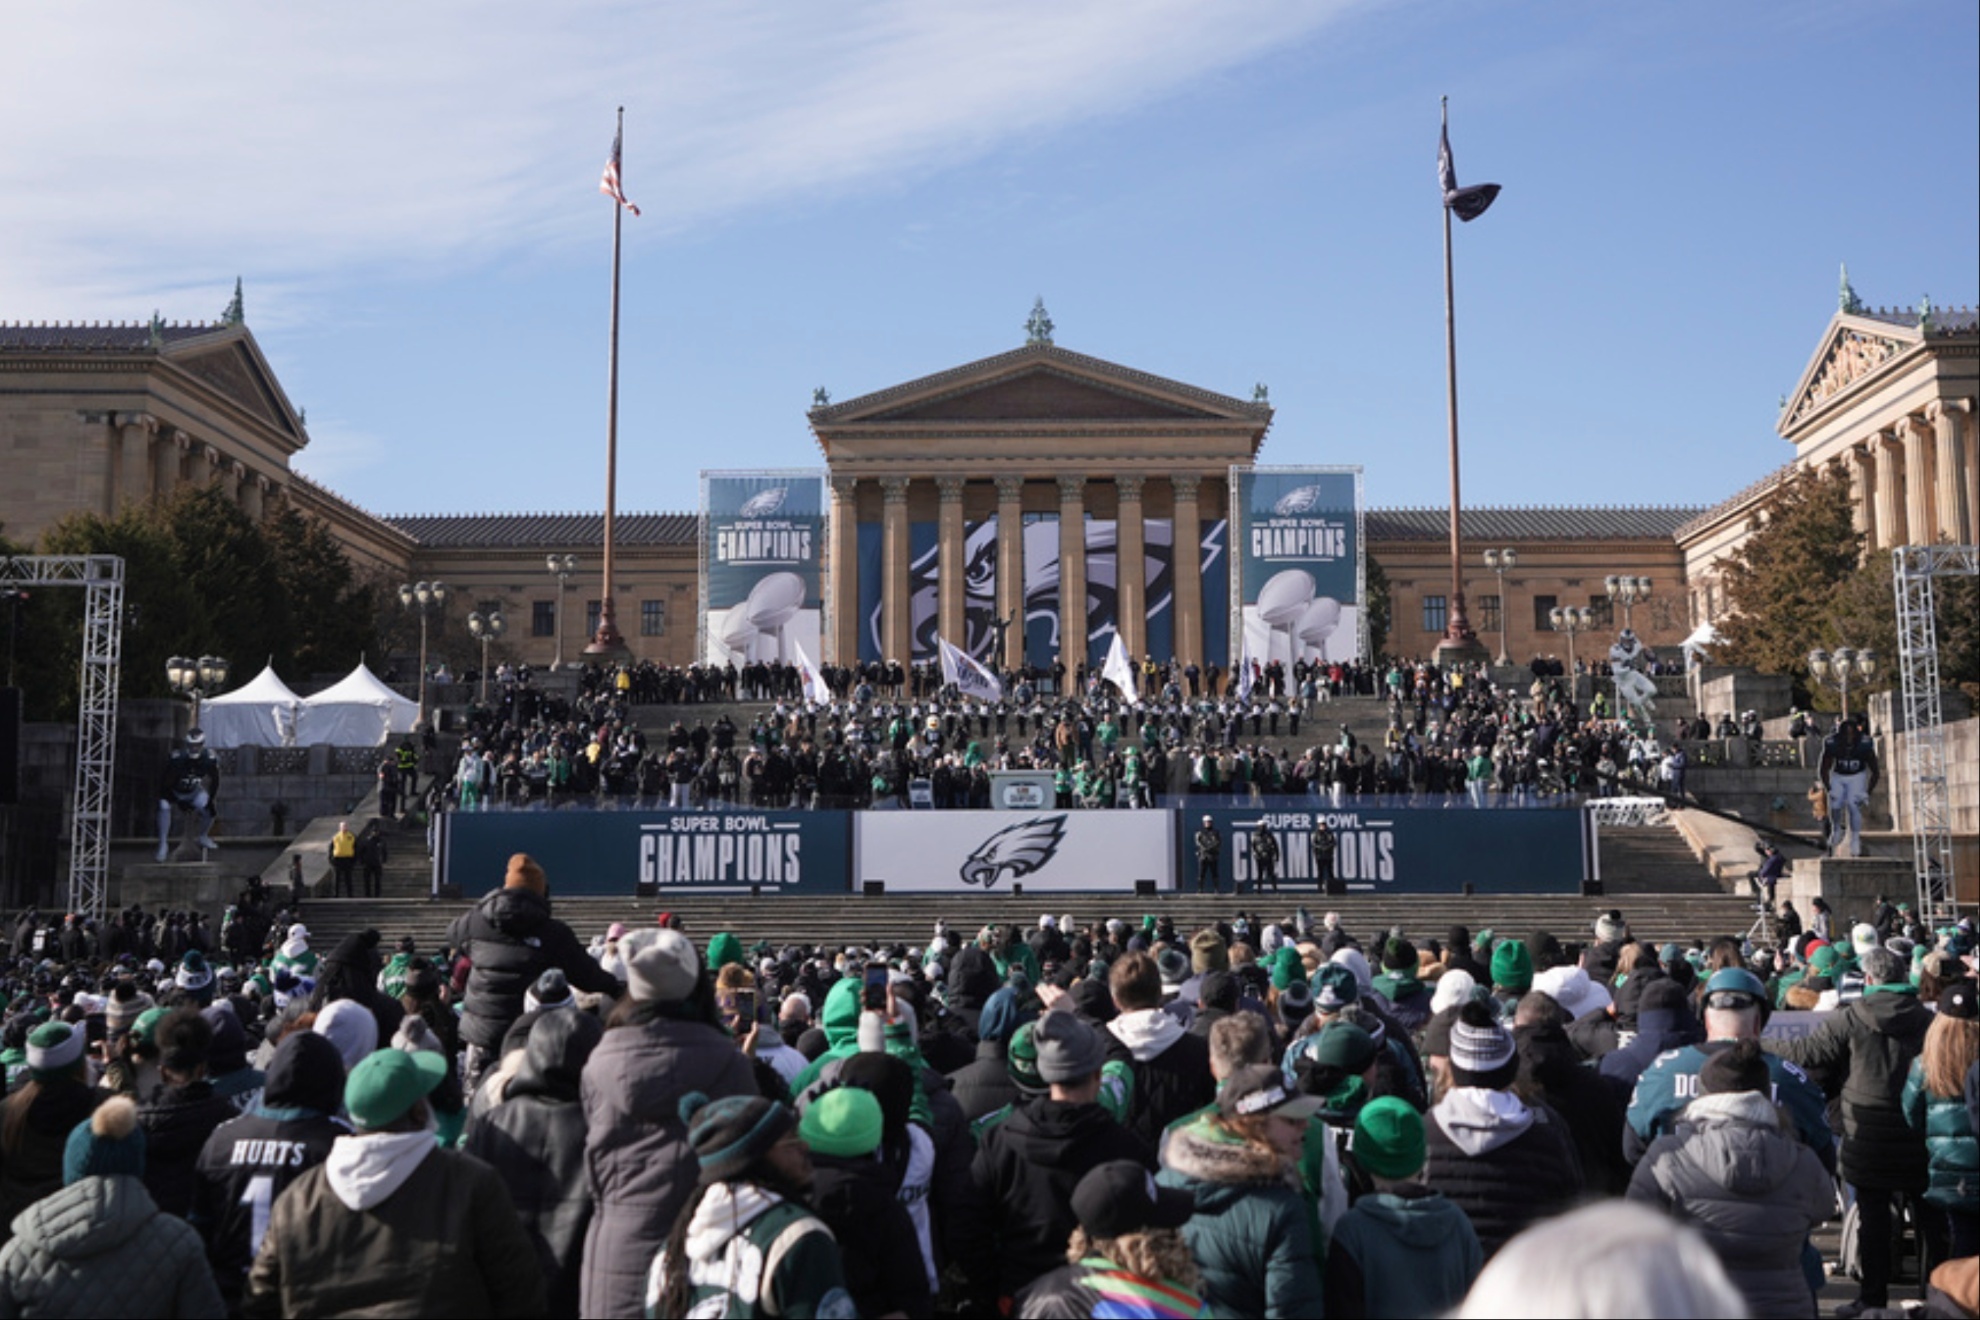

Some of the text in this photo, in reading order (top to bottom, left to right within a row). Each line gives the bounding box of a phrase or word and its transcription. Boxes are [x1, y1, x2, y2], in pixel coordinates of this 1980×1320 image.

[734, 520, 793, 530] SUPER BOWL
[1269, 518, 1327, 528] SUPER BOWL
[717, 531, 812, 562] CHAMPIONS
[1252, 528, 1346, 558] CHAMPIONS
[670, 816, 770, 832] SUPER BOWL
[1317, 812, 1362, 829] OWL
[640, 833, 800, 884] CHAMPIONS
[230, 1139, 307, 1167] HURTS
